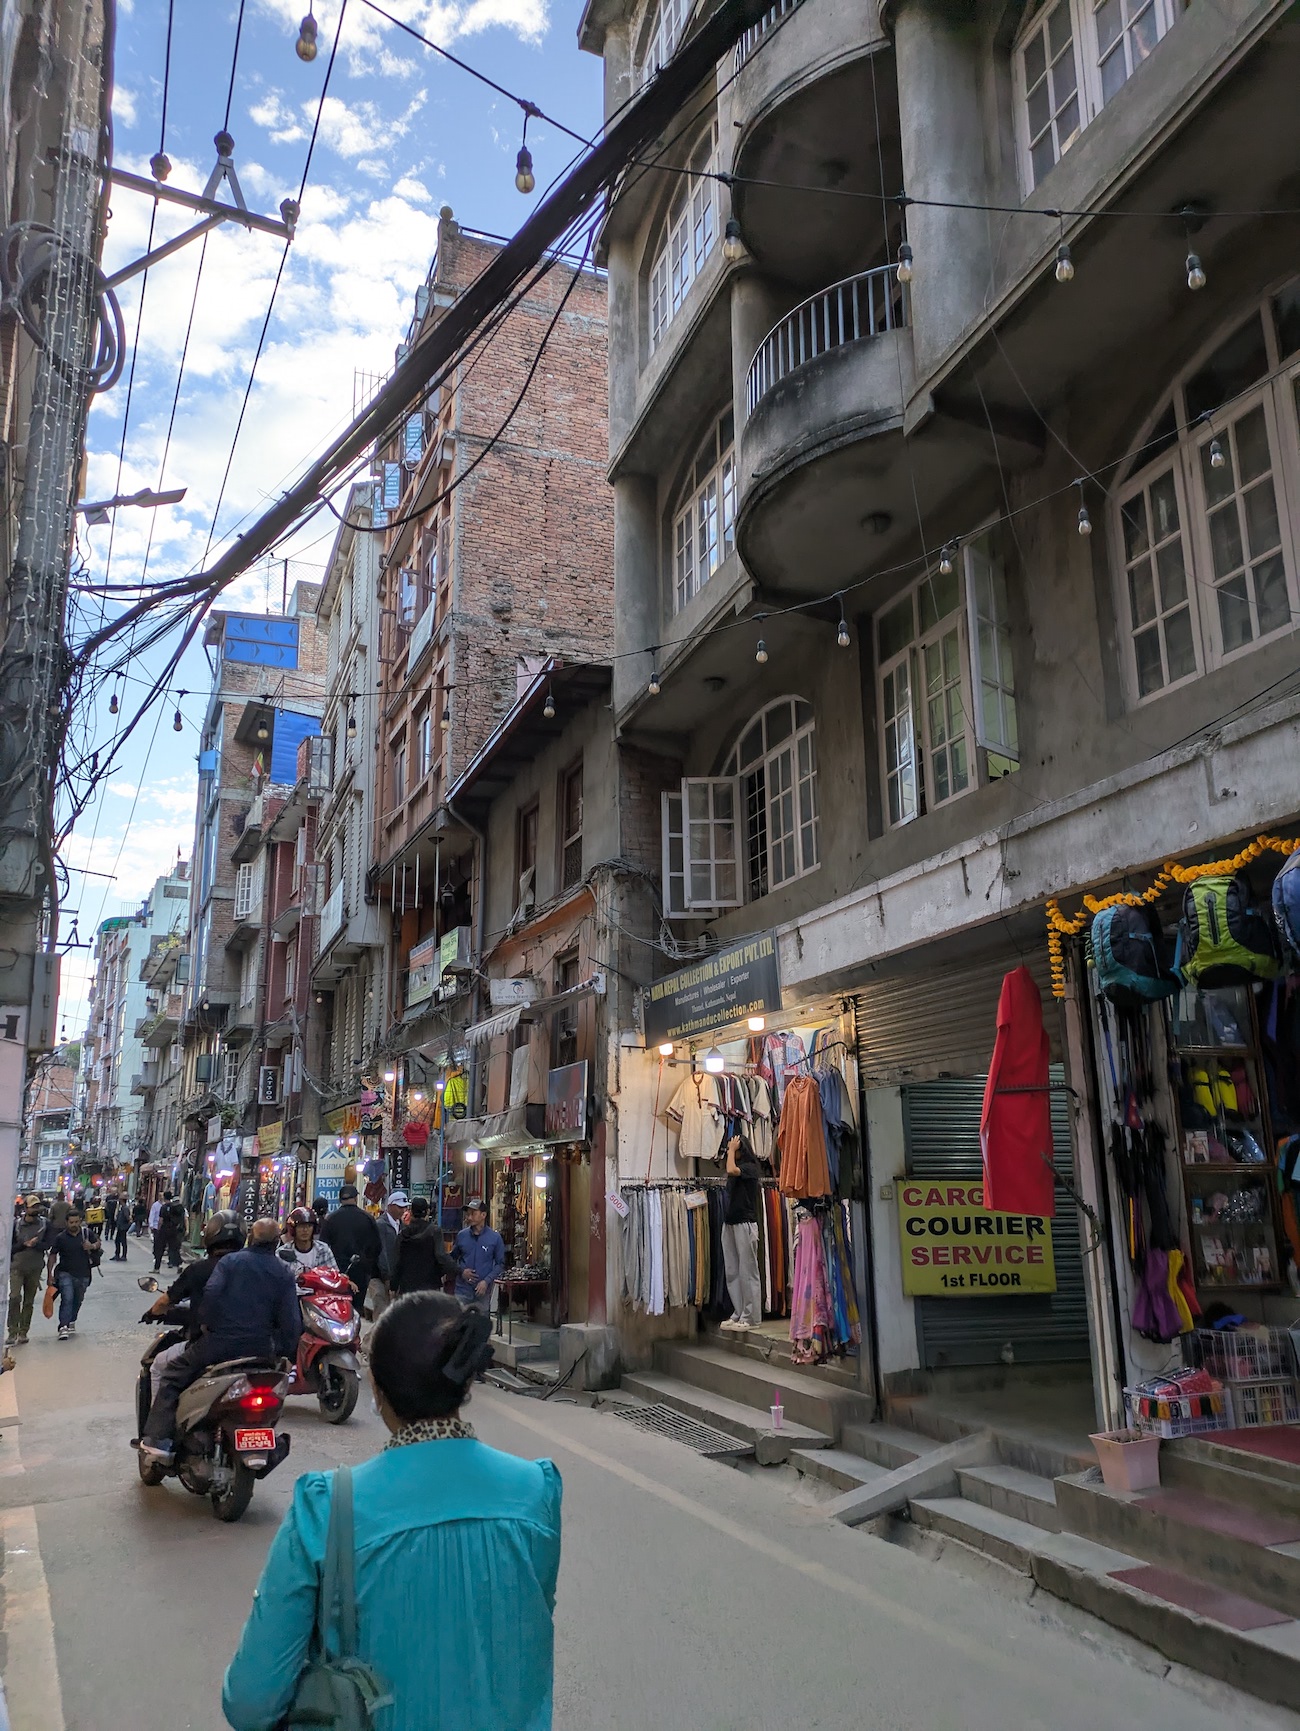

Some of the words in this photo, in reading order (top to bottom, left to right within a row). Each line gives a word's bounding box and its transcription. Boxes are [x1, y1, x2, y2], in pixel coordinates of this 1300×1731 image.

[664, 976, 680, 997] NEPAL
[679, 962, 713, 991] COLLECTION
[713, 962, 719, 977] &
[719, 949, 744, 974] EXPORT
[744, 943, 759, 964] PVT.
[759, 936, 774, 959] LTD.
[703, 980, 726, 996] Wholesaler
[730, 971, 750, 985] Exporter
[725, 990, 737, 1003] Nepal
[667, 998, 765, 1037] www.kathmanducollection.com
[265, 1070, 274, 1100] TATTOO
[318, 1178, 346, 1188] RENT
[244, 1179, 256, 1221] TATTOO
[609, 1194, 625, 1213] 500/-
[902, 1187, 985, 1207] CARG
[905, 1216, 1046, 1238] COURIER
[911, 1245, 1044, 1266] SERVICE
[940, 1274, 965, 1288] 1st
[969, 1273, 1021, 1287] FLOOR
